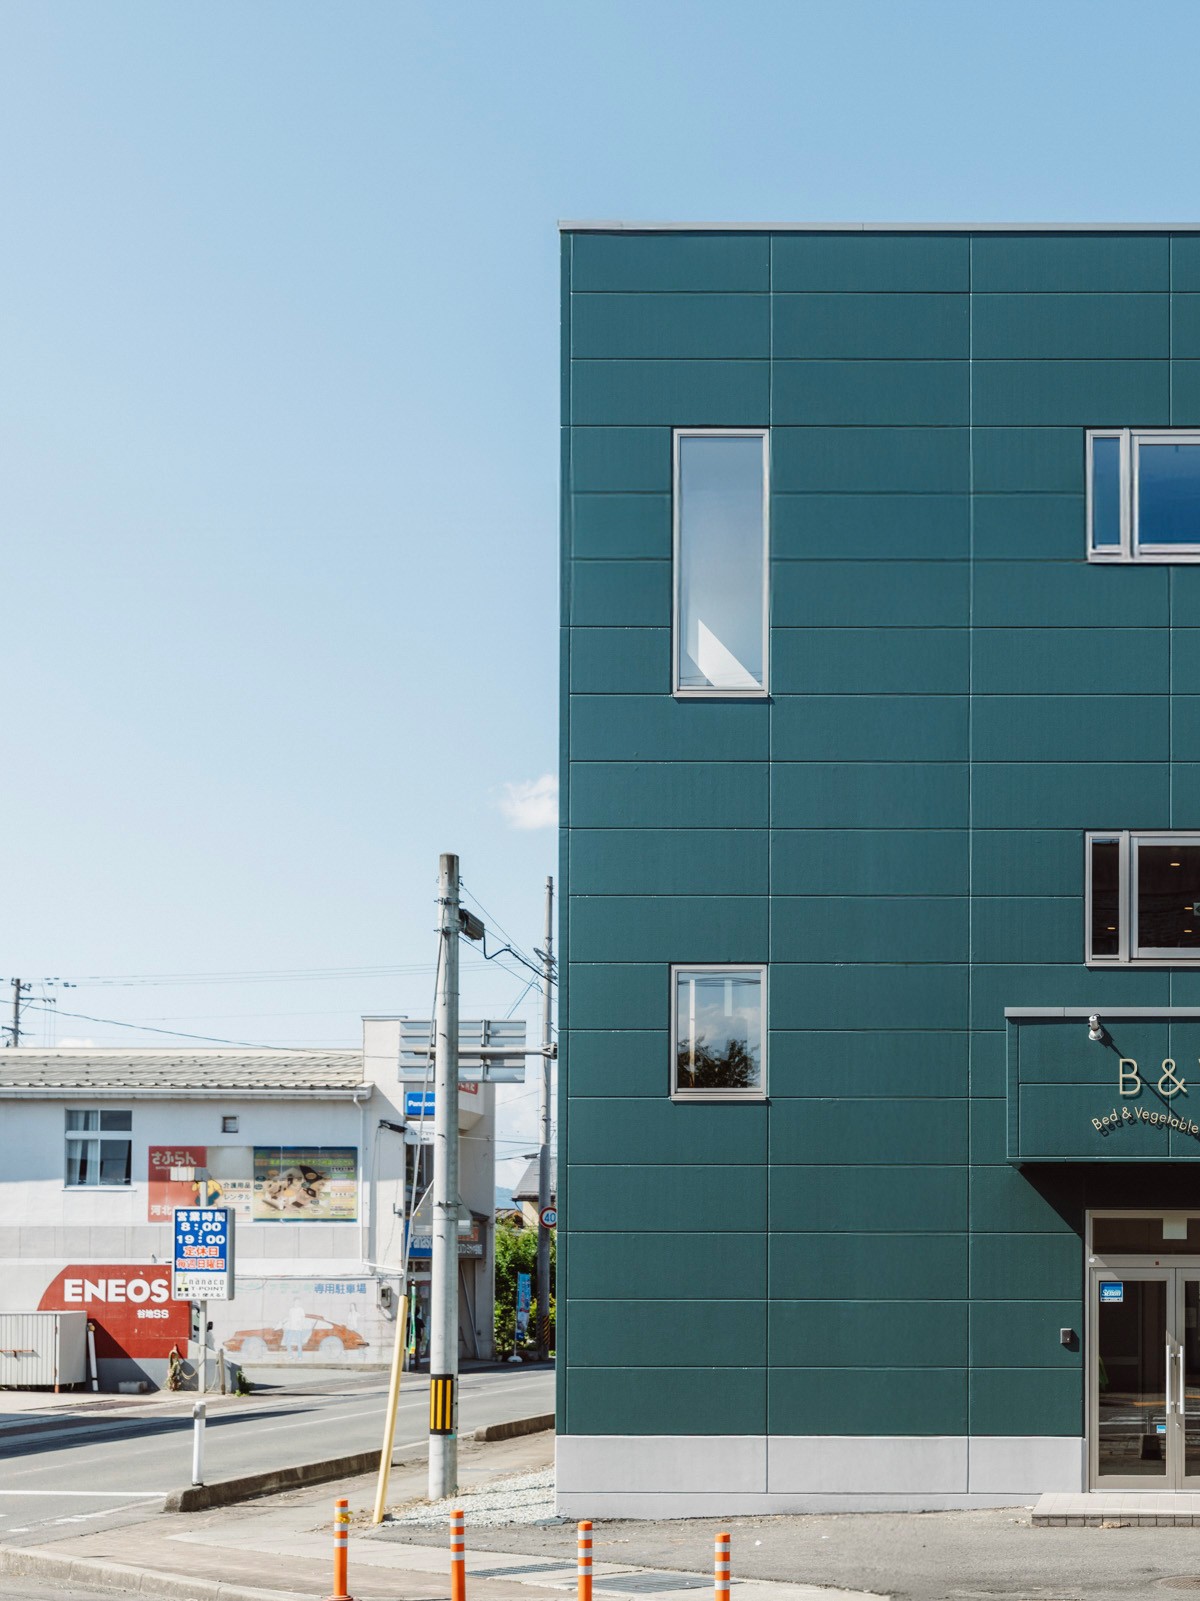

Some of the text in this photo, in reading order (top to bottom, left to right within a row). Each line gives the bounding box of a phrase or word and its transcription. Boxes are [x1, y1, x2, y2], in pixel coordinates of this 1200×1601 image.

[1119, 1058, 1141, 1095] B
[1158, 1058, 1187, 1095] &
[1091, 1108, 1118, 1130] Bed
[1122, 1106, 1132, 1119] &
[1134, 1106, 1199, 1134] Vegetable
[176, 1211, 226, 1222] 営業時間
[544, 1212, 556, 1222] 40
[183, 1246, 219, 1257] 定休日
[176, 1258, 225, 1270] 毎週日曜日
[64, 1278, 169, 1303] ENEOS
[314, 1283, 367, 1294] 専用駐車場
